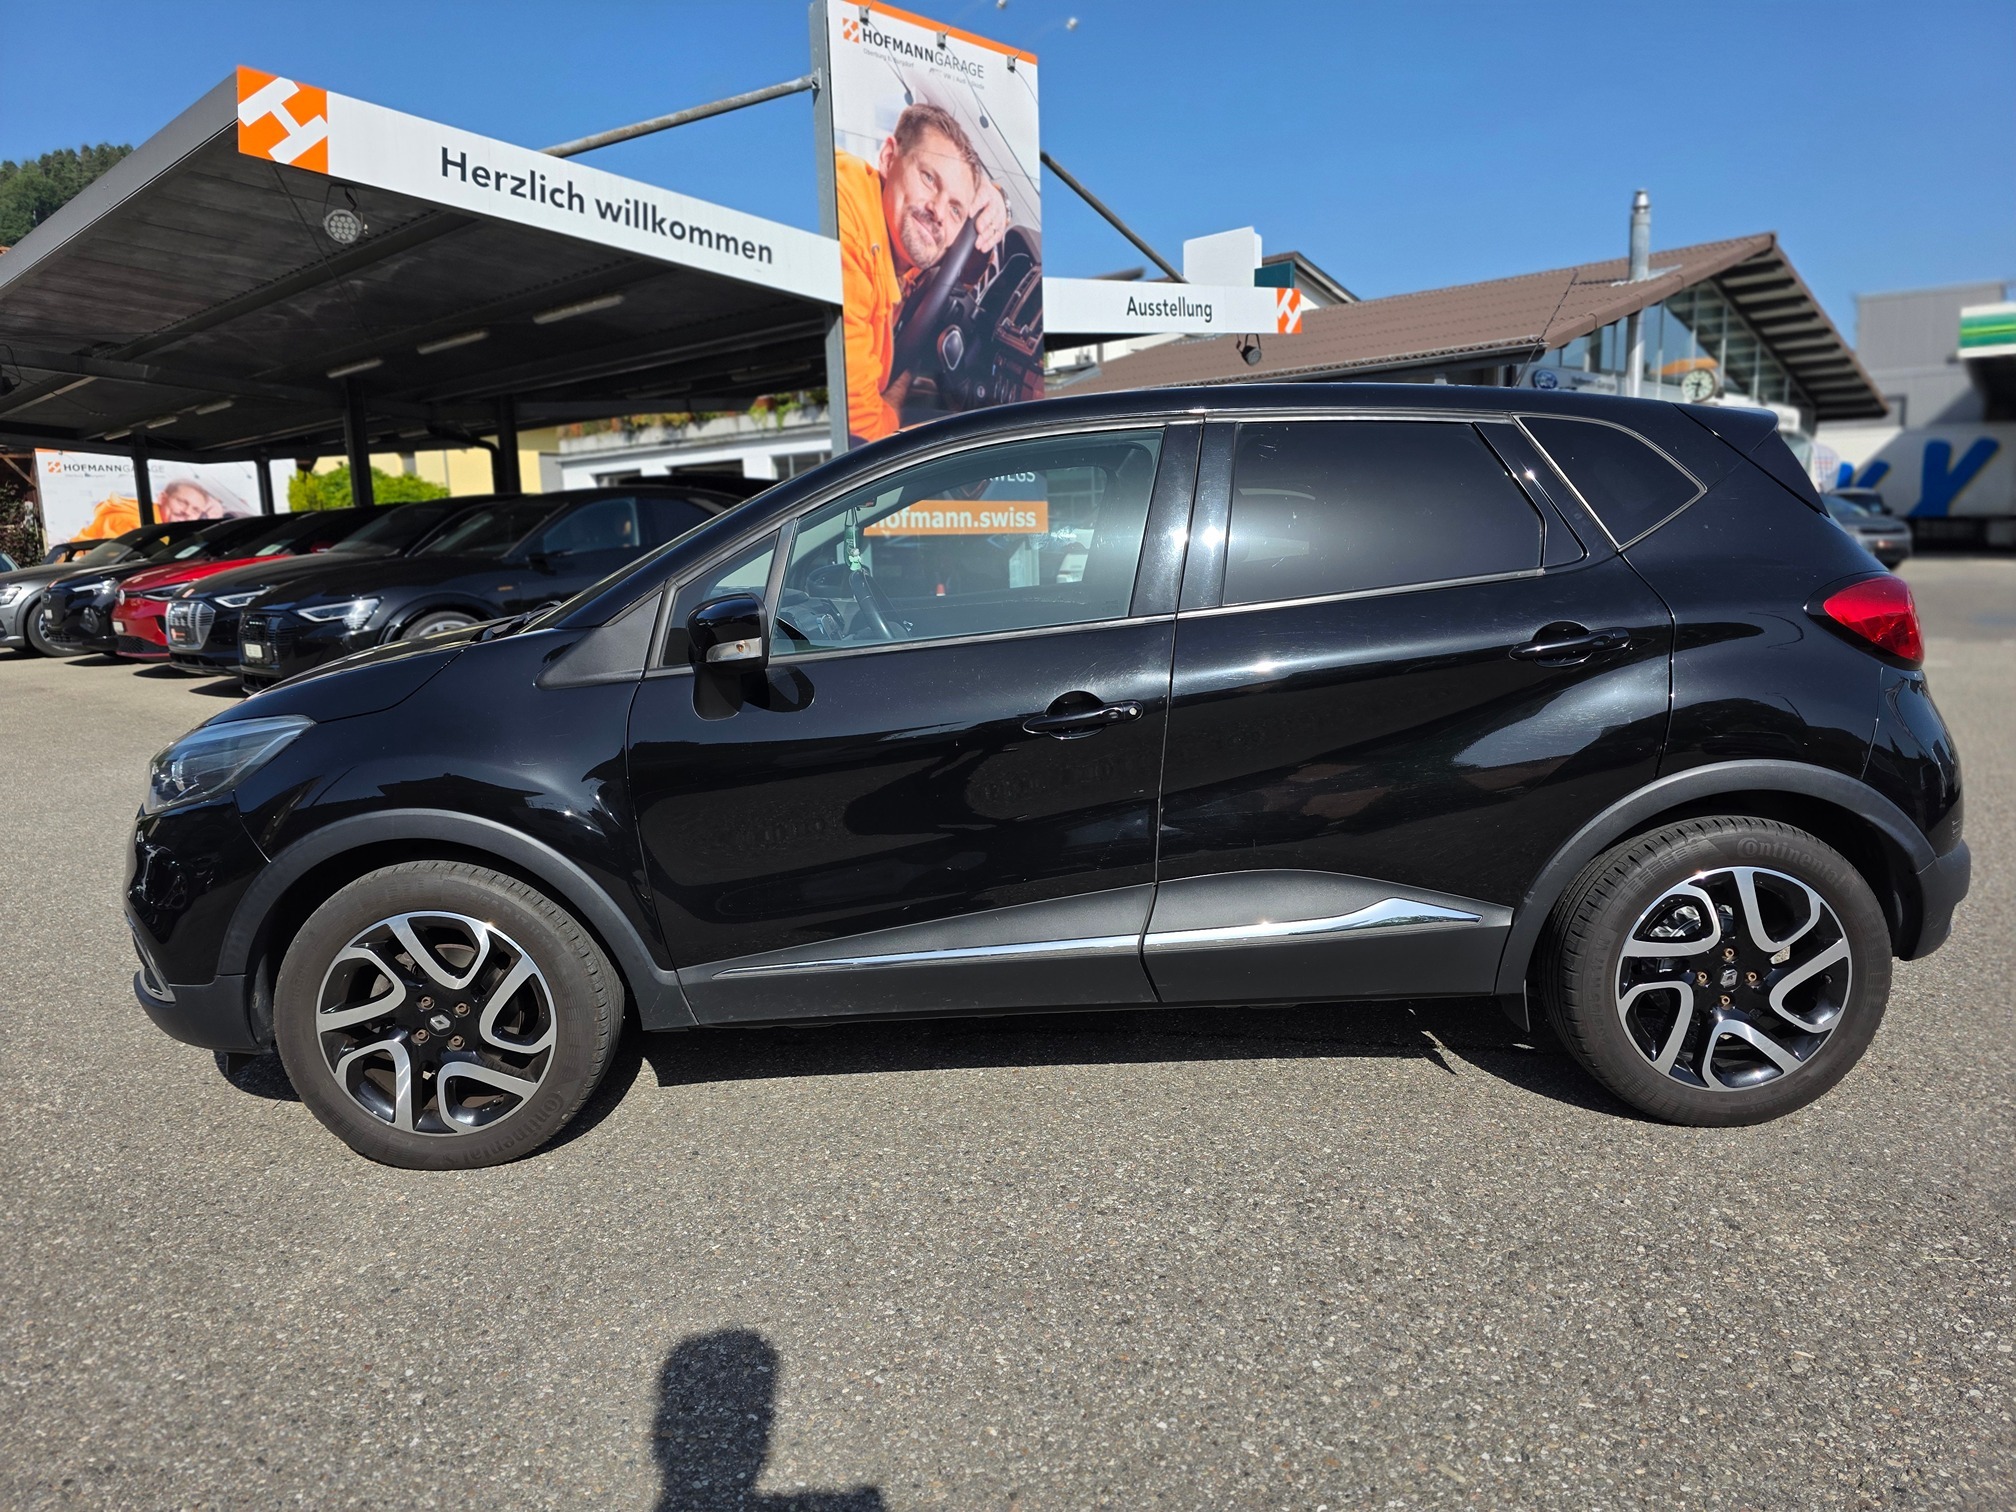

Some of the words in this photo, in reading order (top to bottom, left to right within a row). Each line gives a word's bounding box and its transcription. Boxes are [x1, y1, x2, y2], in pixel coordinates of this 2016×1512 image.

[441, 146, 585, 214] Herzlich
[594, 198, 773, 265] willkommen
[1126, 296, 1213, 323] Ausstellung
